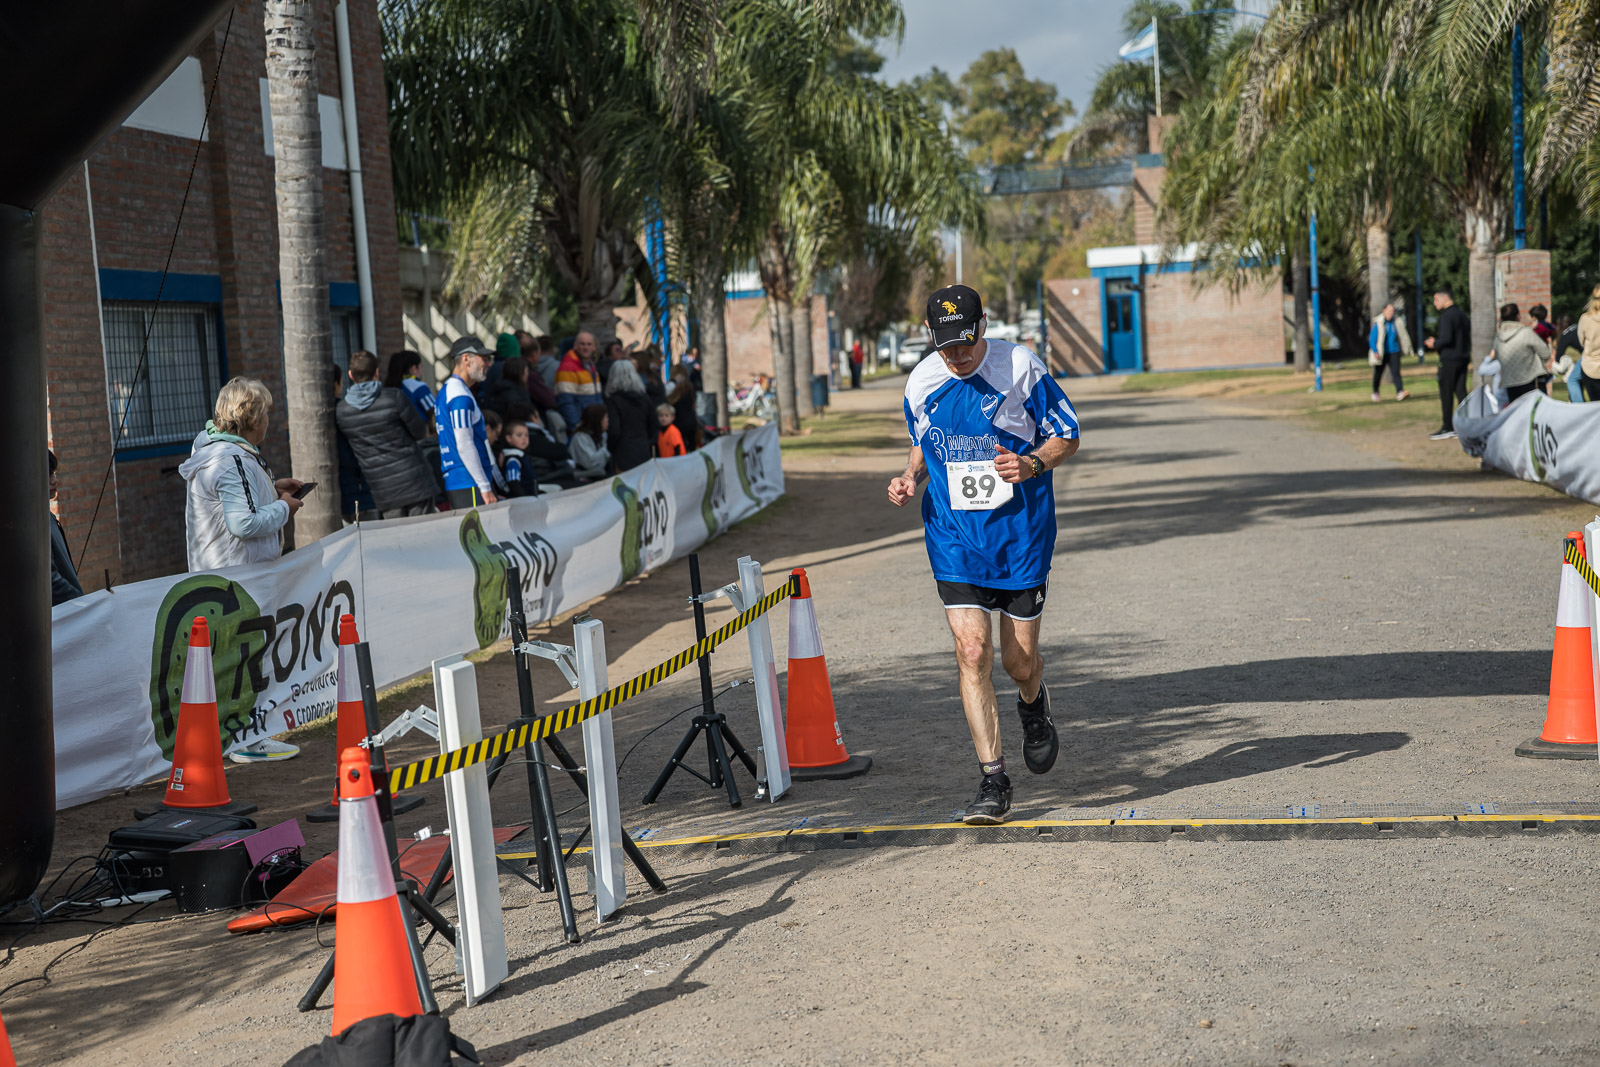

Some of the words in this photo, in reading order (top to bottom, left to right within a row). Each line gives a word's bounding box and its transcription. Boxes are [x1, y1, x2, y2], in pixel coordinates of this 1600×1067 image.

[938, 314, 963, 324] TORINO
[929, 426, 948, 466] 3
[961, 474, 996, 499] 89
